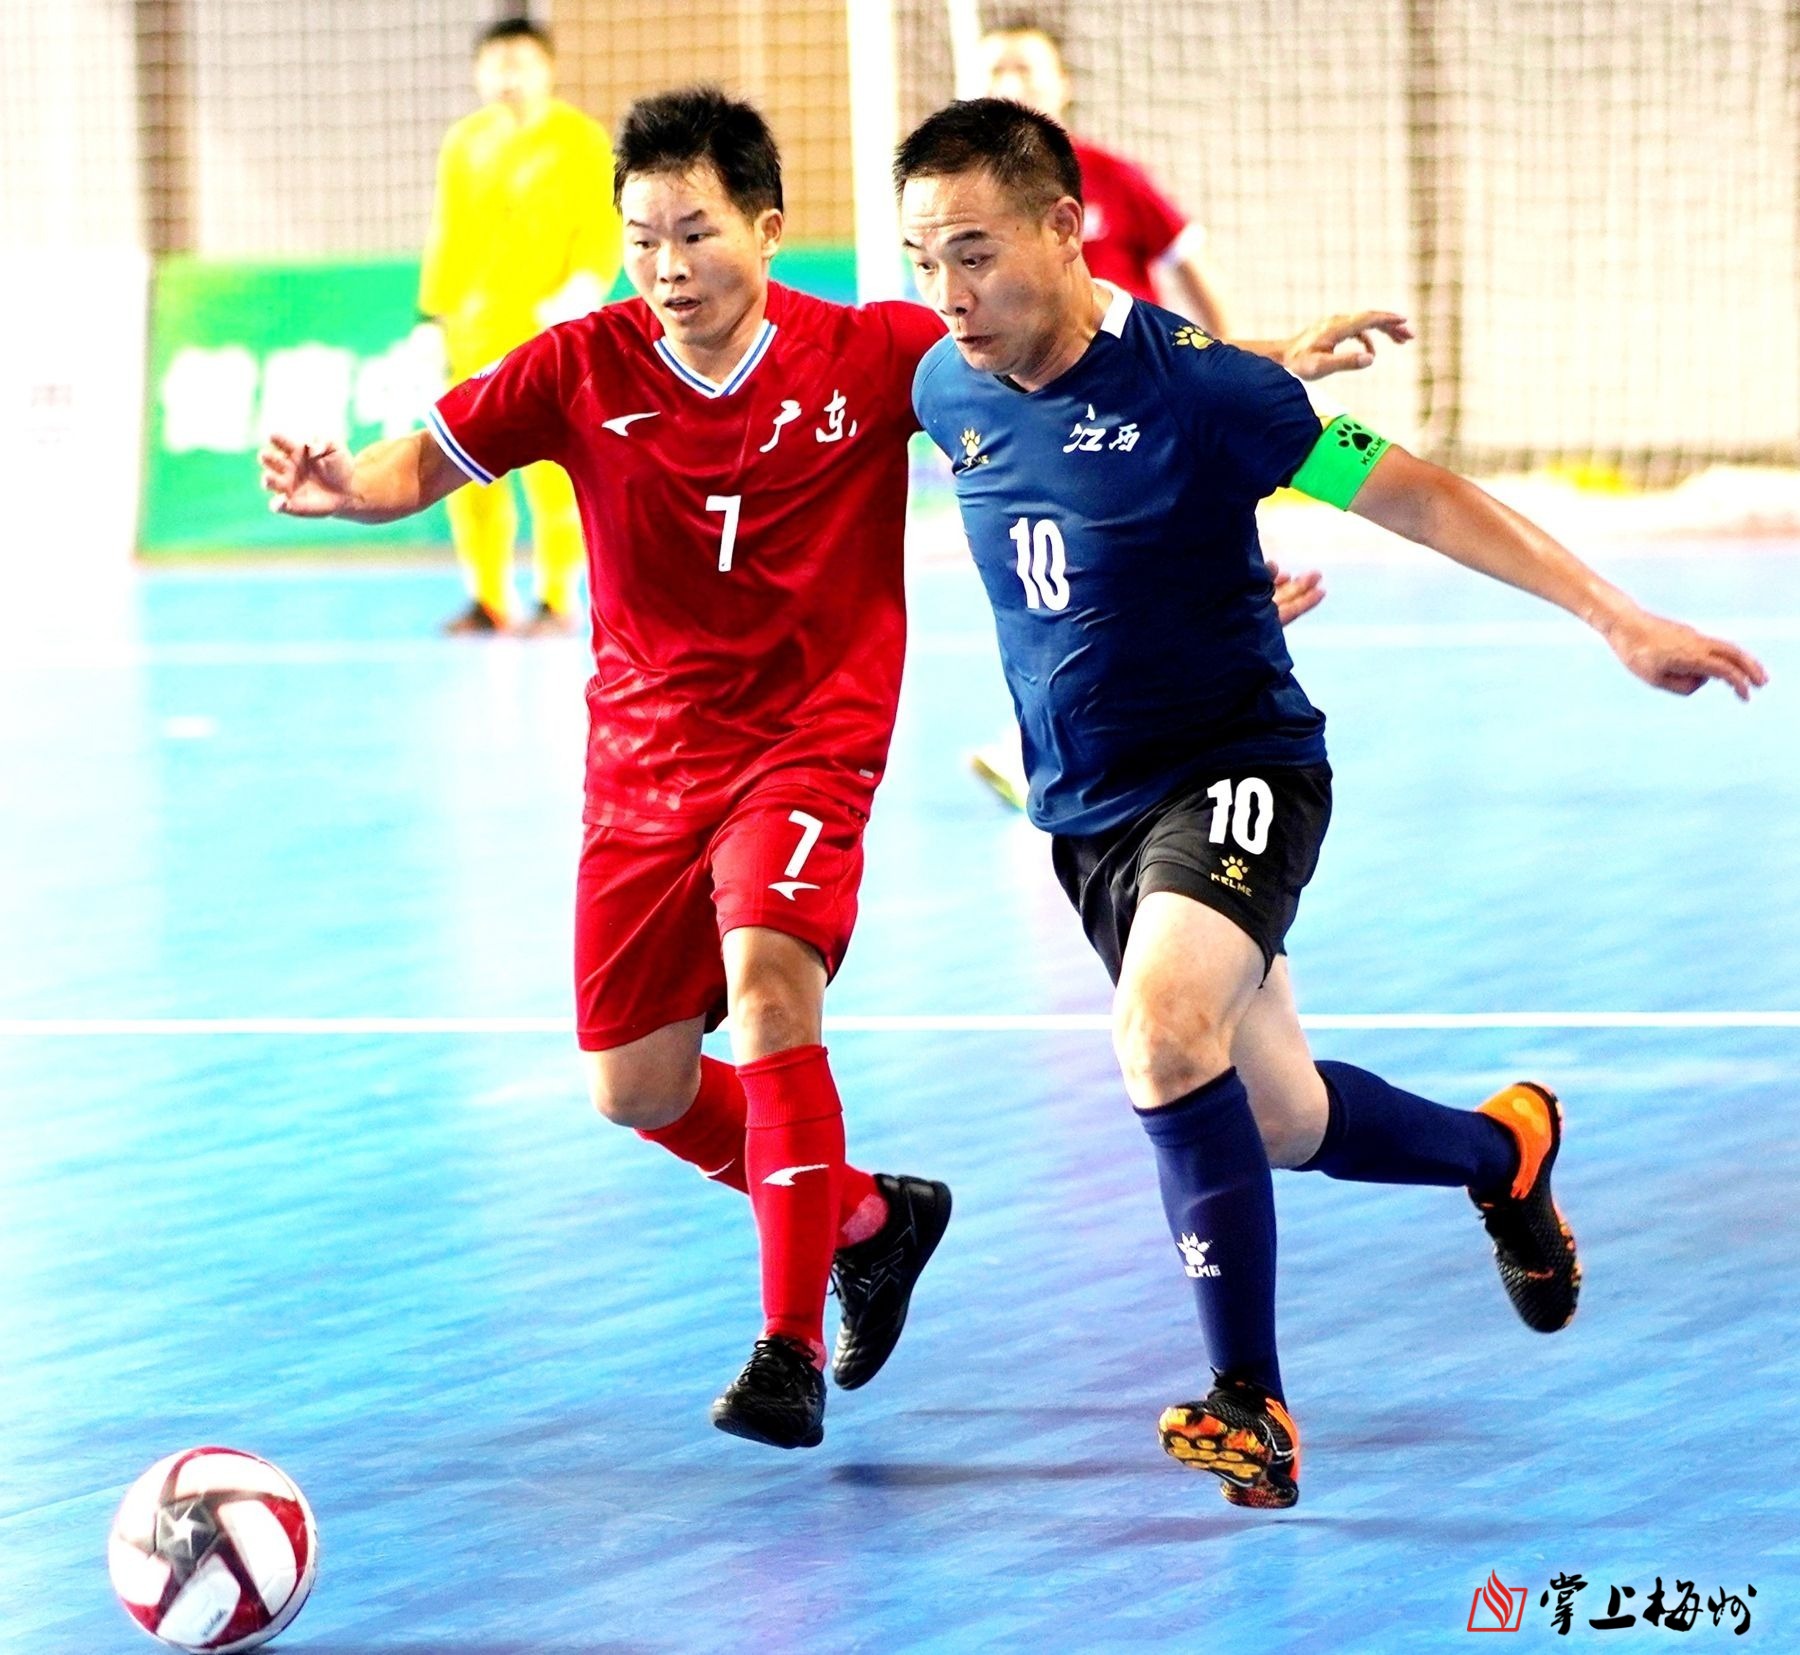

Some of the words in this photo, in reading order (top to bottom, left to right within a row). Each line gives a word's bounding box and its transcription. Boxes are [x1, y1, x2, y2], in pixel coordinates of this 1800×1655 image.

[759, 389, 857, 452] 广东
[1063, 404, 1141, 453] 江西
[705, 494, 742, 572] 7
[1009, 517, 1071, 611] 10
[783, 809, 824, 879] 7
[1206, 776, 1274, 855] 10
[1210, 872, 1253, 897] KELME
